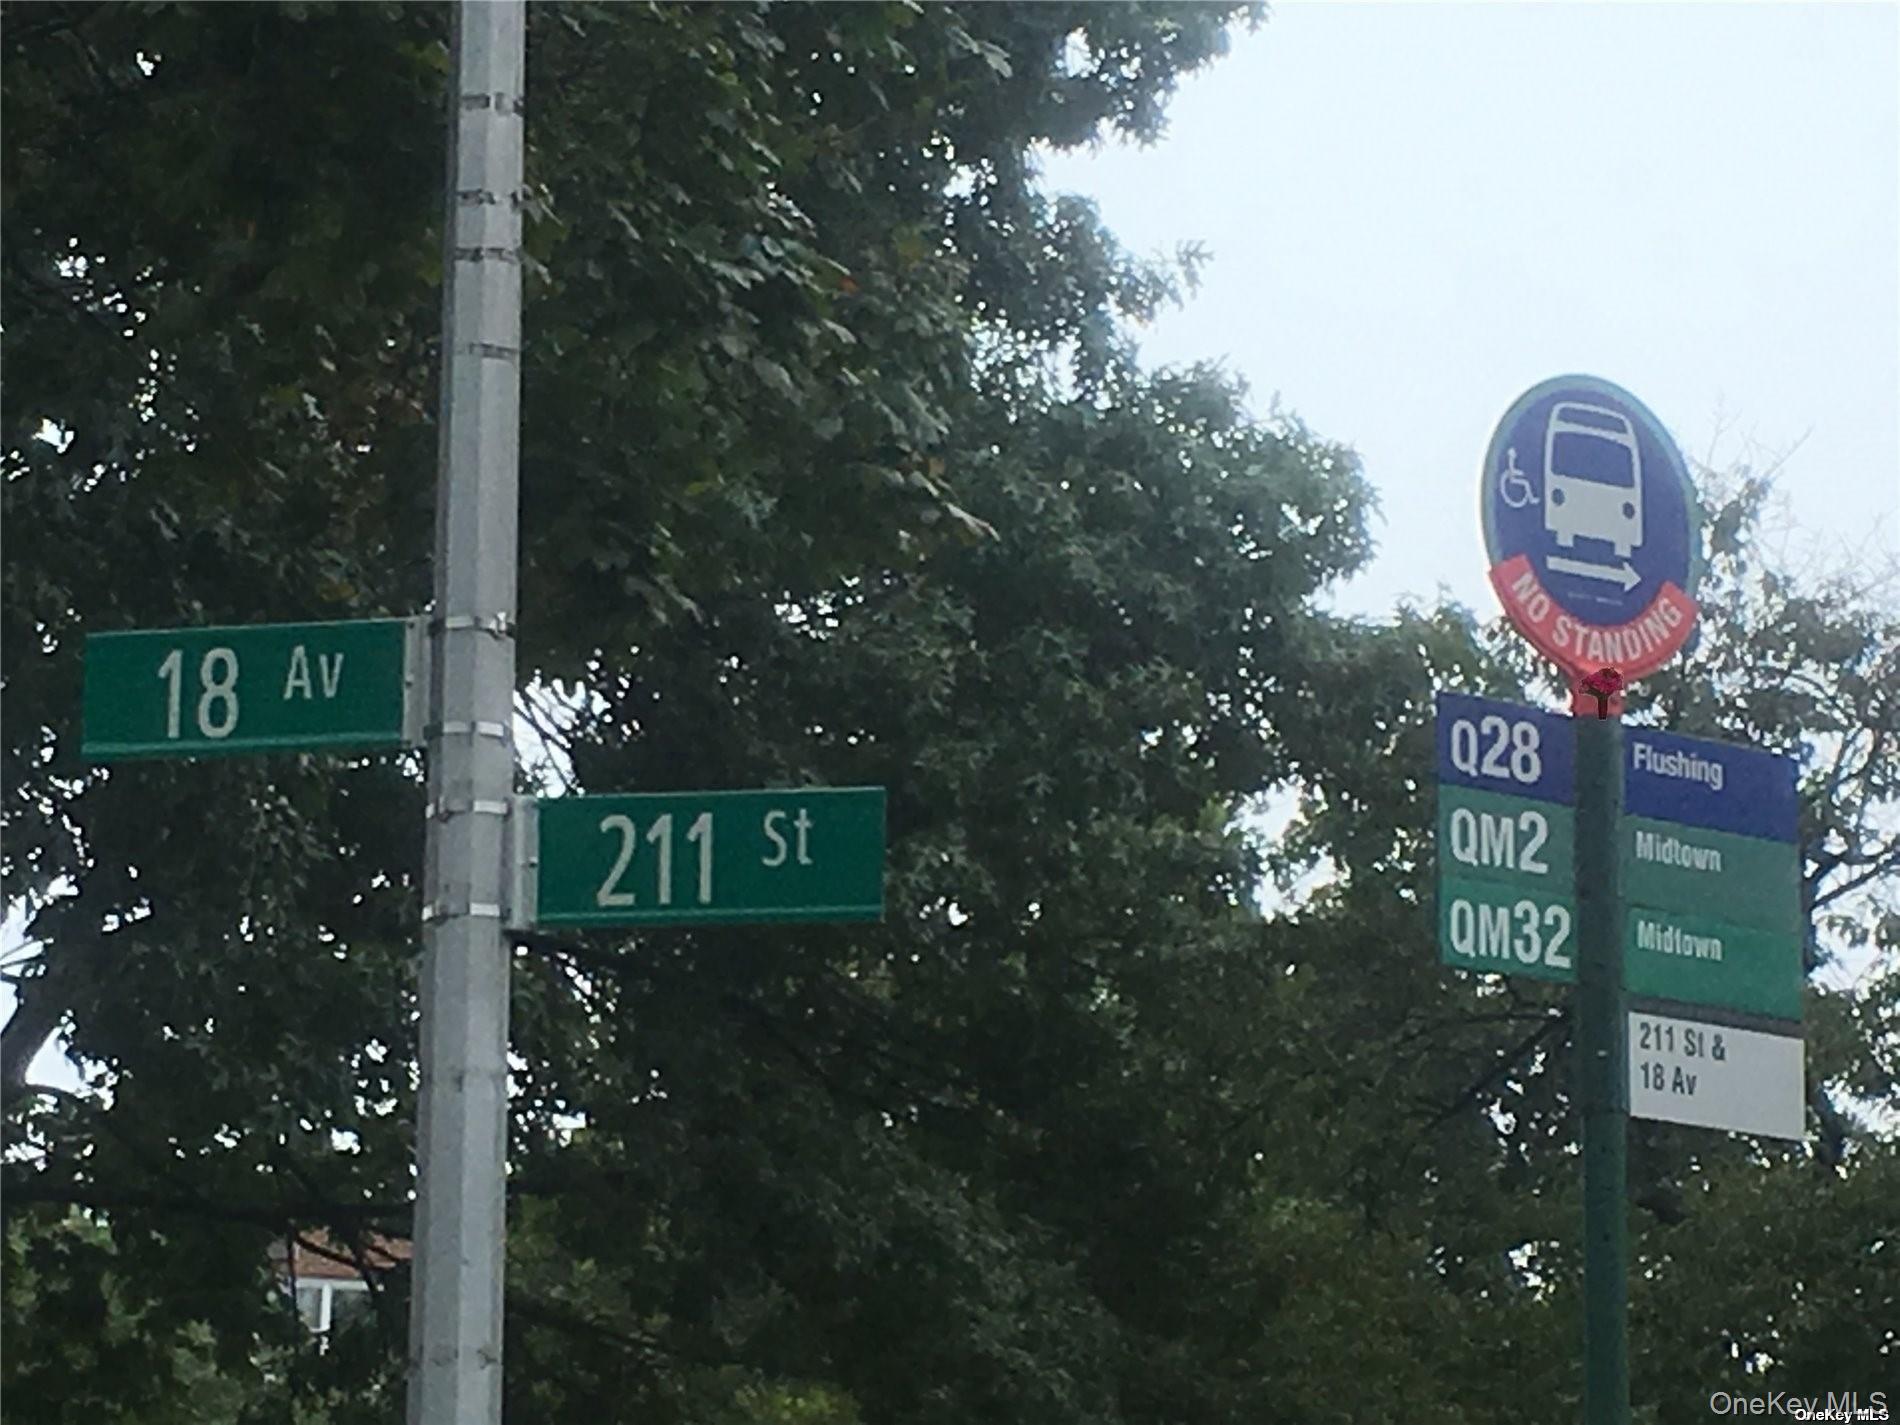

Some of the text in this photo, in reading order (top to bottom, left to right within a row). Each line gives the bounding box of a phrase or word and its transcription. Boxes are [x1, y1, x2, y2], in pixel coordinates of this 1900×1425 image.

[1511, 572, 1683, 663] NO STANDING
[157, 645, 344, 738] 18 Av
[1451, 715, 1541, 784] Q28
[1633, 742, 1723, 790] Flushing
[597, 808, 814, 906] 211 St
[1450, 808, 1548, 874] QM2
[1635, 830, 1722, 872] Midtown
[1450, 899, 1571, 968] QM32
[1637, 919, 1722, 962] Midtown
[1639, 1022, 1726, 1061] 211 St &
[1640, 1062, 1698, 1095] 18 Av
